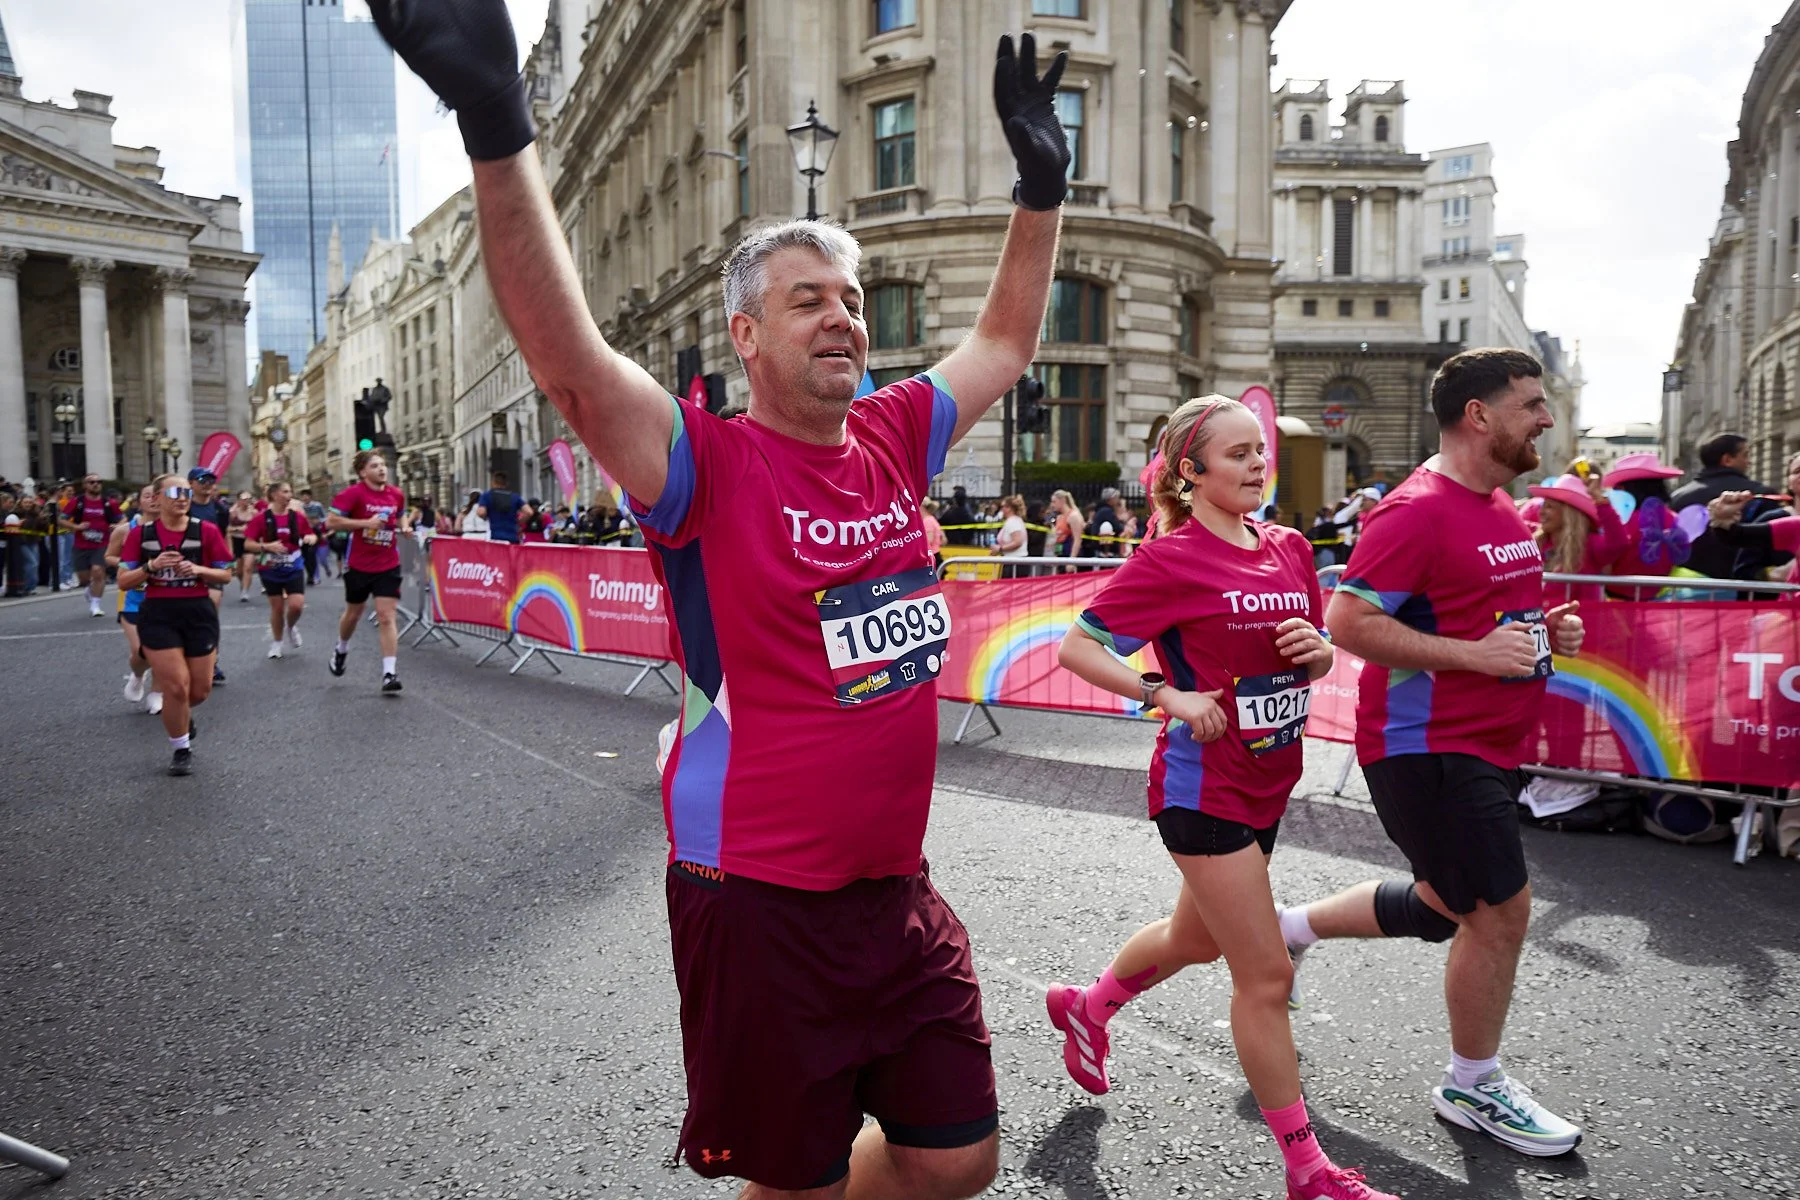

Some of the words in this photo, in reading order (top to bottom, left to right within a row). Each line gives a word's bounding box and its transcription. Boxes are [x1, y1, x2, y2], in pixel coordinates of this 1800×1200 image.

[871, 581, 899, 597] CARL
[836, 600, 945, 660] 10693
[1227, 622, 1243, 630] The
[1272, 674, 1295, 685] FREYA
[1246, 688, 1310, 725] 10217
[1730, 719, 1769, 736] The
